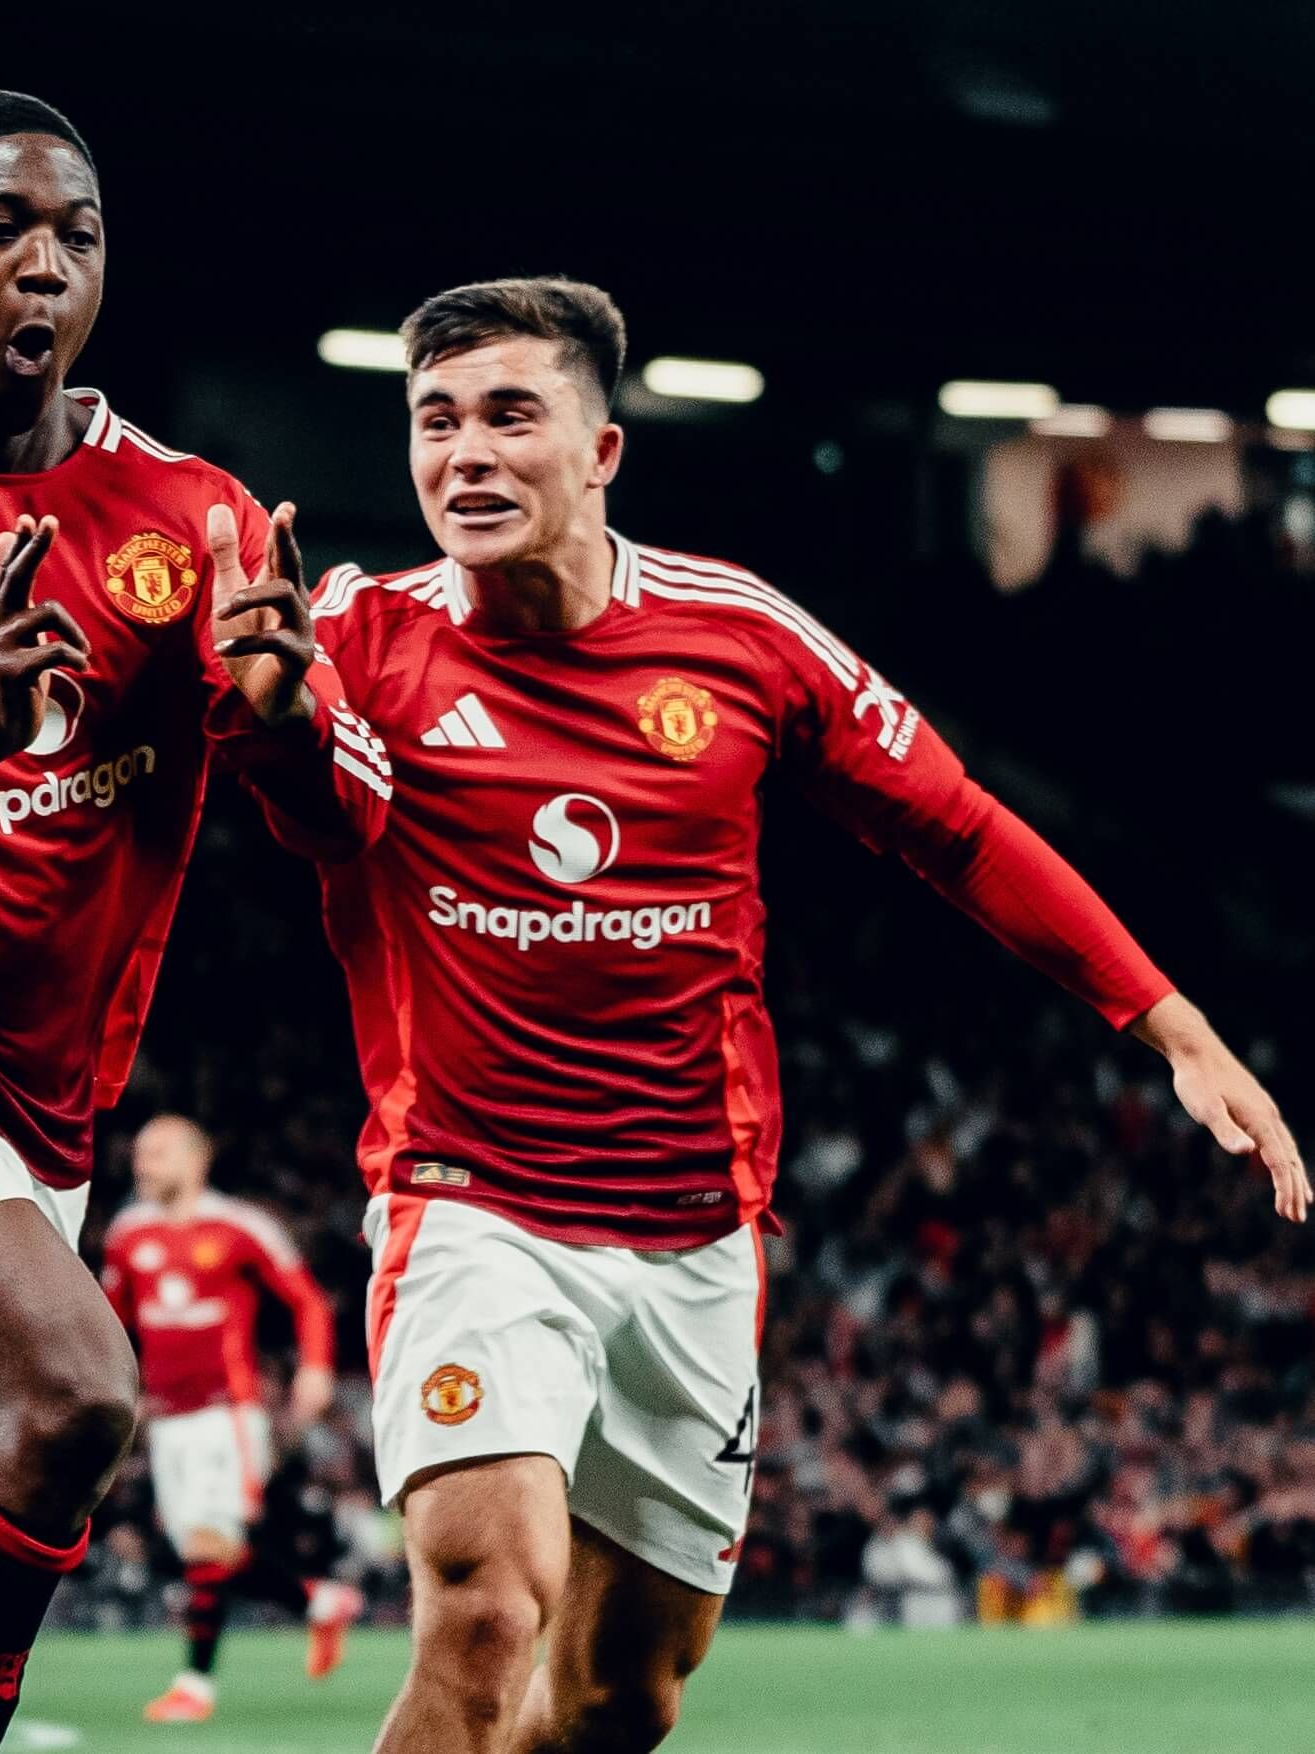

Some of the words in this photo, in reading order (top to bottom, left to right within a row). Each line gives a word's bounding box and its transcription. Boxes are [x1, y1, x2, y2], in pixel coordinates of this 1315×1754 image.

[113, 539, 186, 570] MANCHESTER
[131, 599, 182, 618] UNITED
[888, 709, 919, 762] TECHNO
[428, 886, 711, 951] Snapdragon
[714, 1384, 755, 1496] 4
